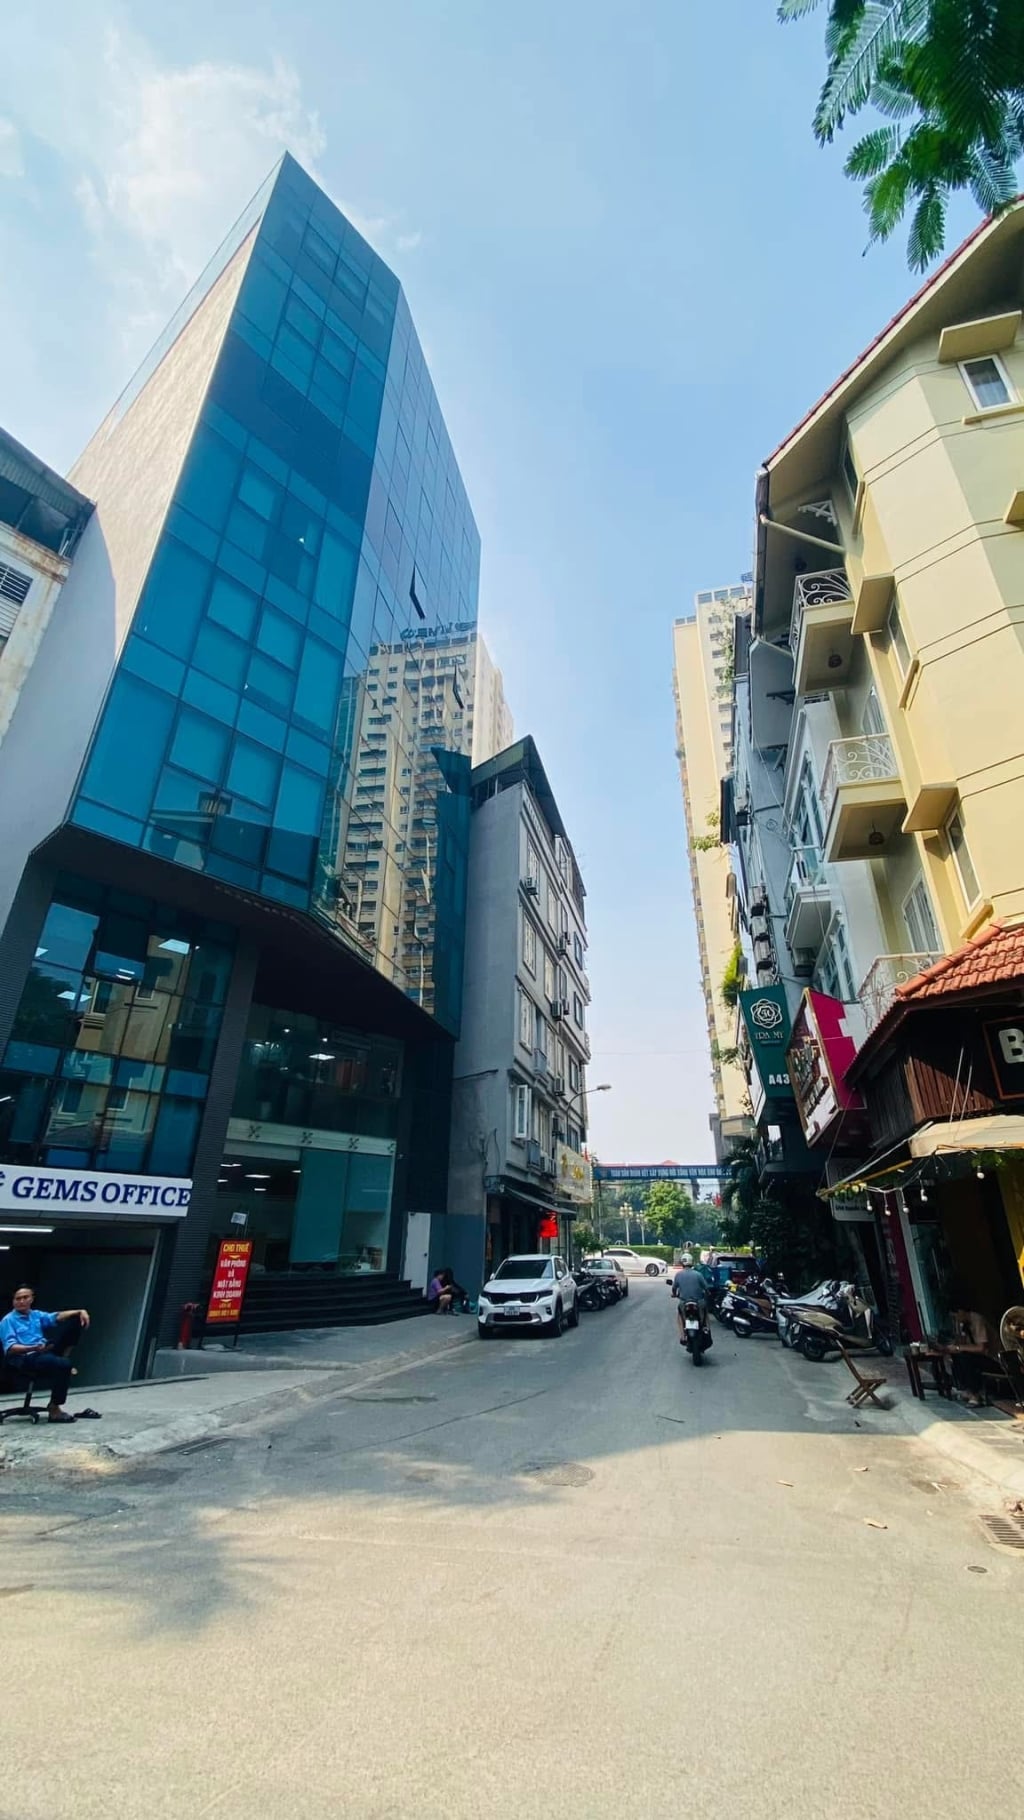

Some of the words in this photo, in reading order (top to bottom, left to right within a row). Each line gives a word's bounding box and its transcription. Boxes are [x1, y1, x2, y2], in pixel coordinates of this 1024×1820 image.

[768, 1074, 790, 1085] A43
[12, 1176, 99, 1202] GEMS
[101, 1181, 192, 1207] OFFICE
